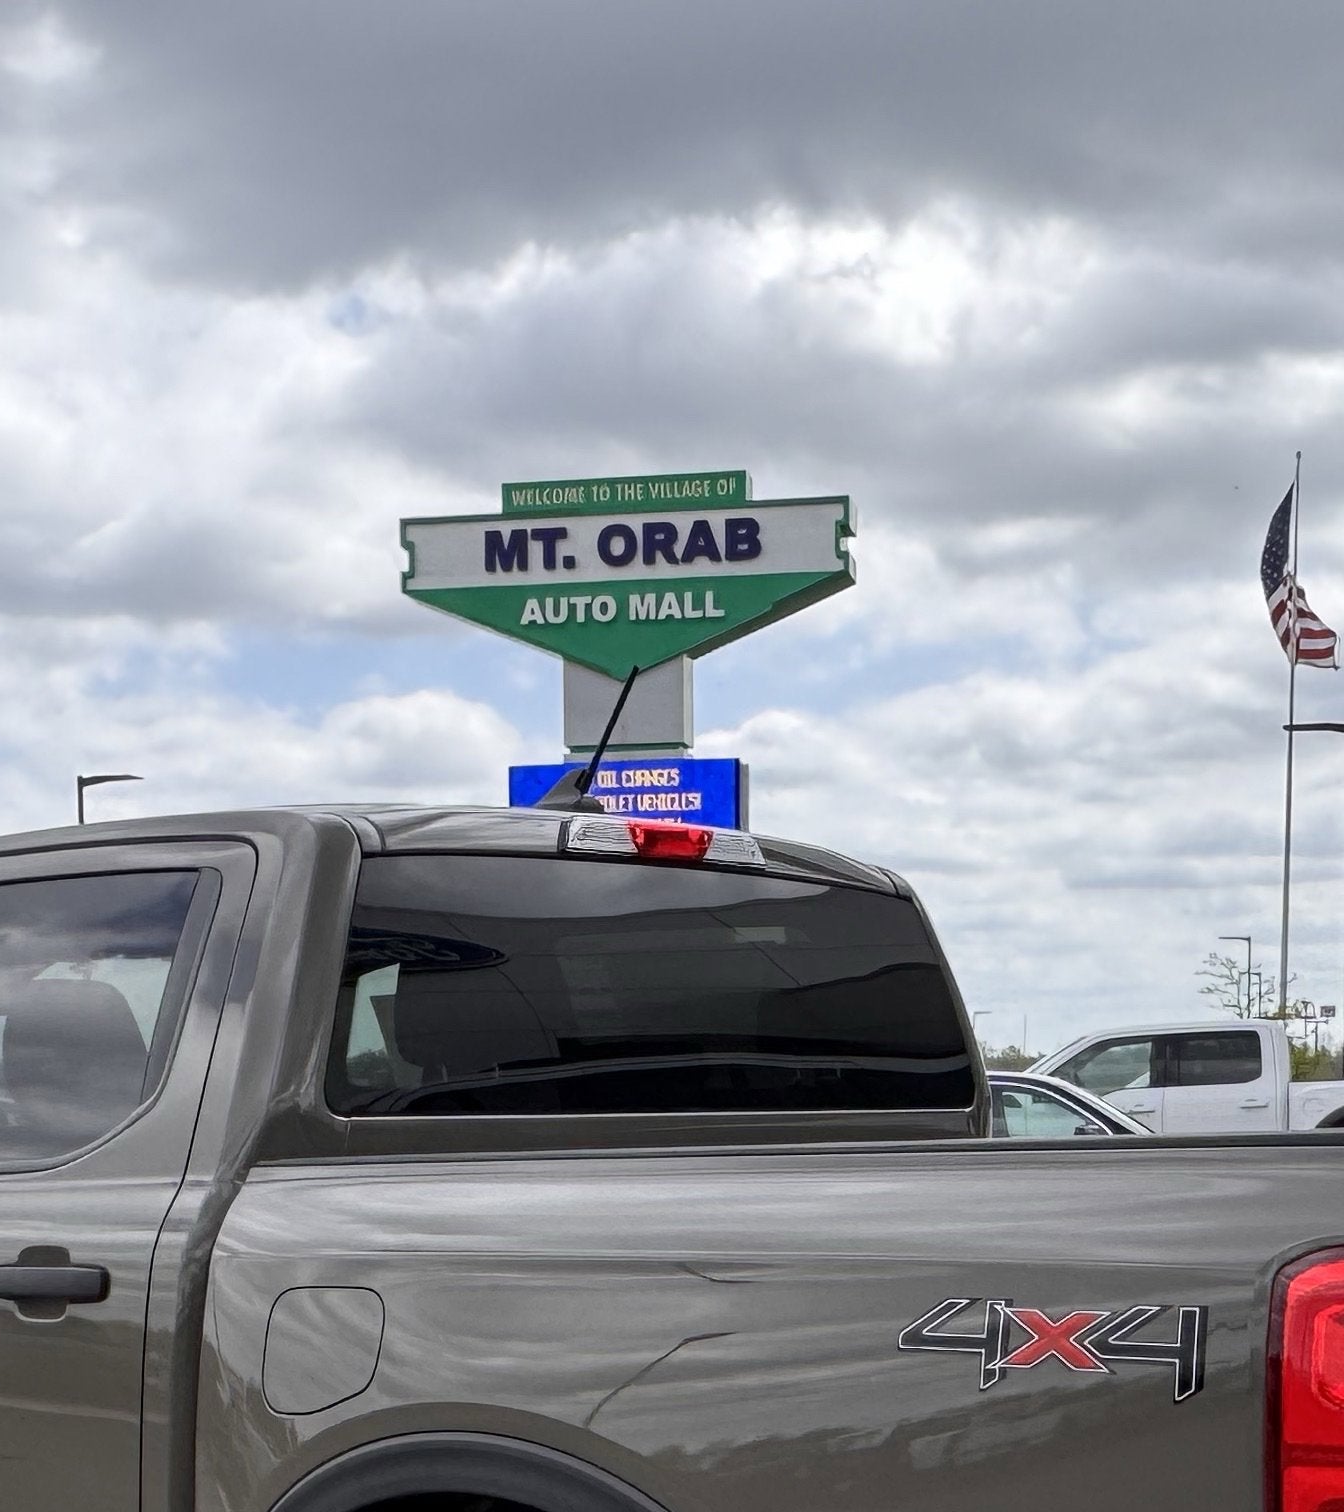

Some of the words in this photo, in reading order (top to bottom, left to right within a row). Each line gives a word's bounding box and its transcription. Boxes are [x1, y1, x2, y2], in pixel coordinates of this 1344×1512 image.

[512, 486, 585, 506] WELCOME
[592, 485, 610, 502] TO
[616, 483, 644, 501] THE
[648, 480, 711, 500] VILLAGE
[484, 527, 576, 572] MT.
[597, 518, 762, 567] ORAB
[520, 595, 617, 625] AUTO
[629, 591, 725, 621] MALL
